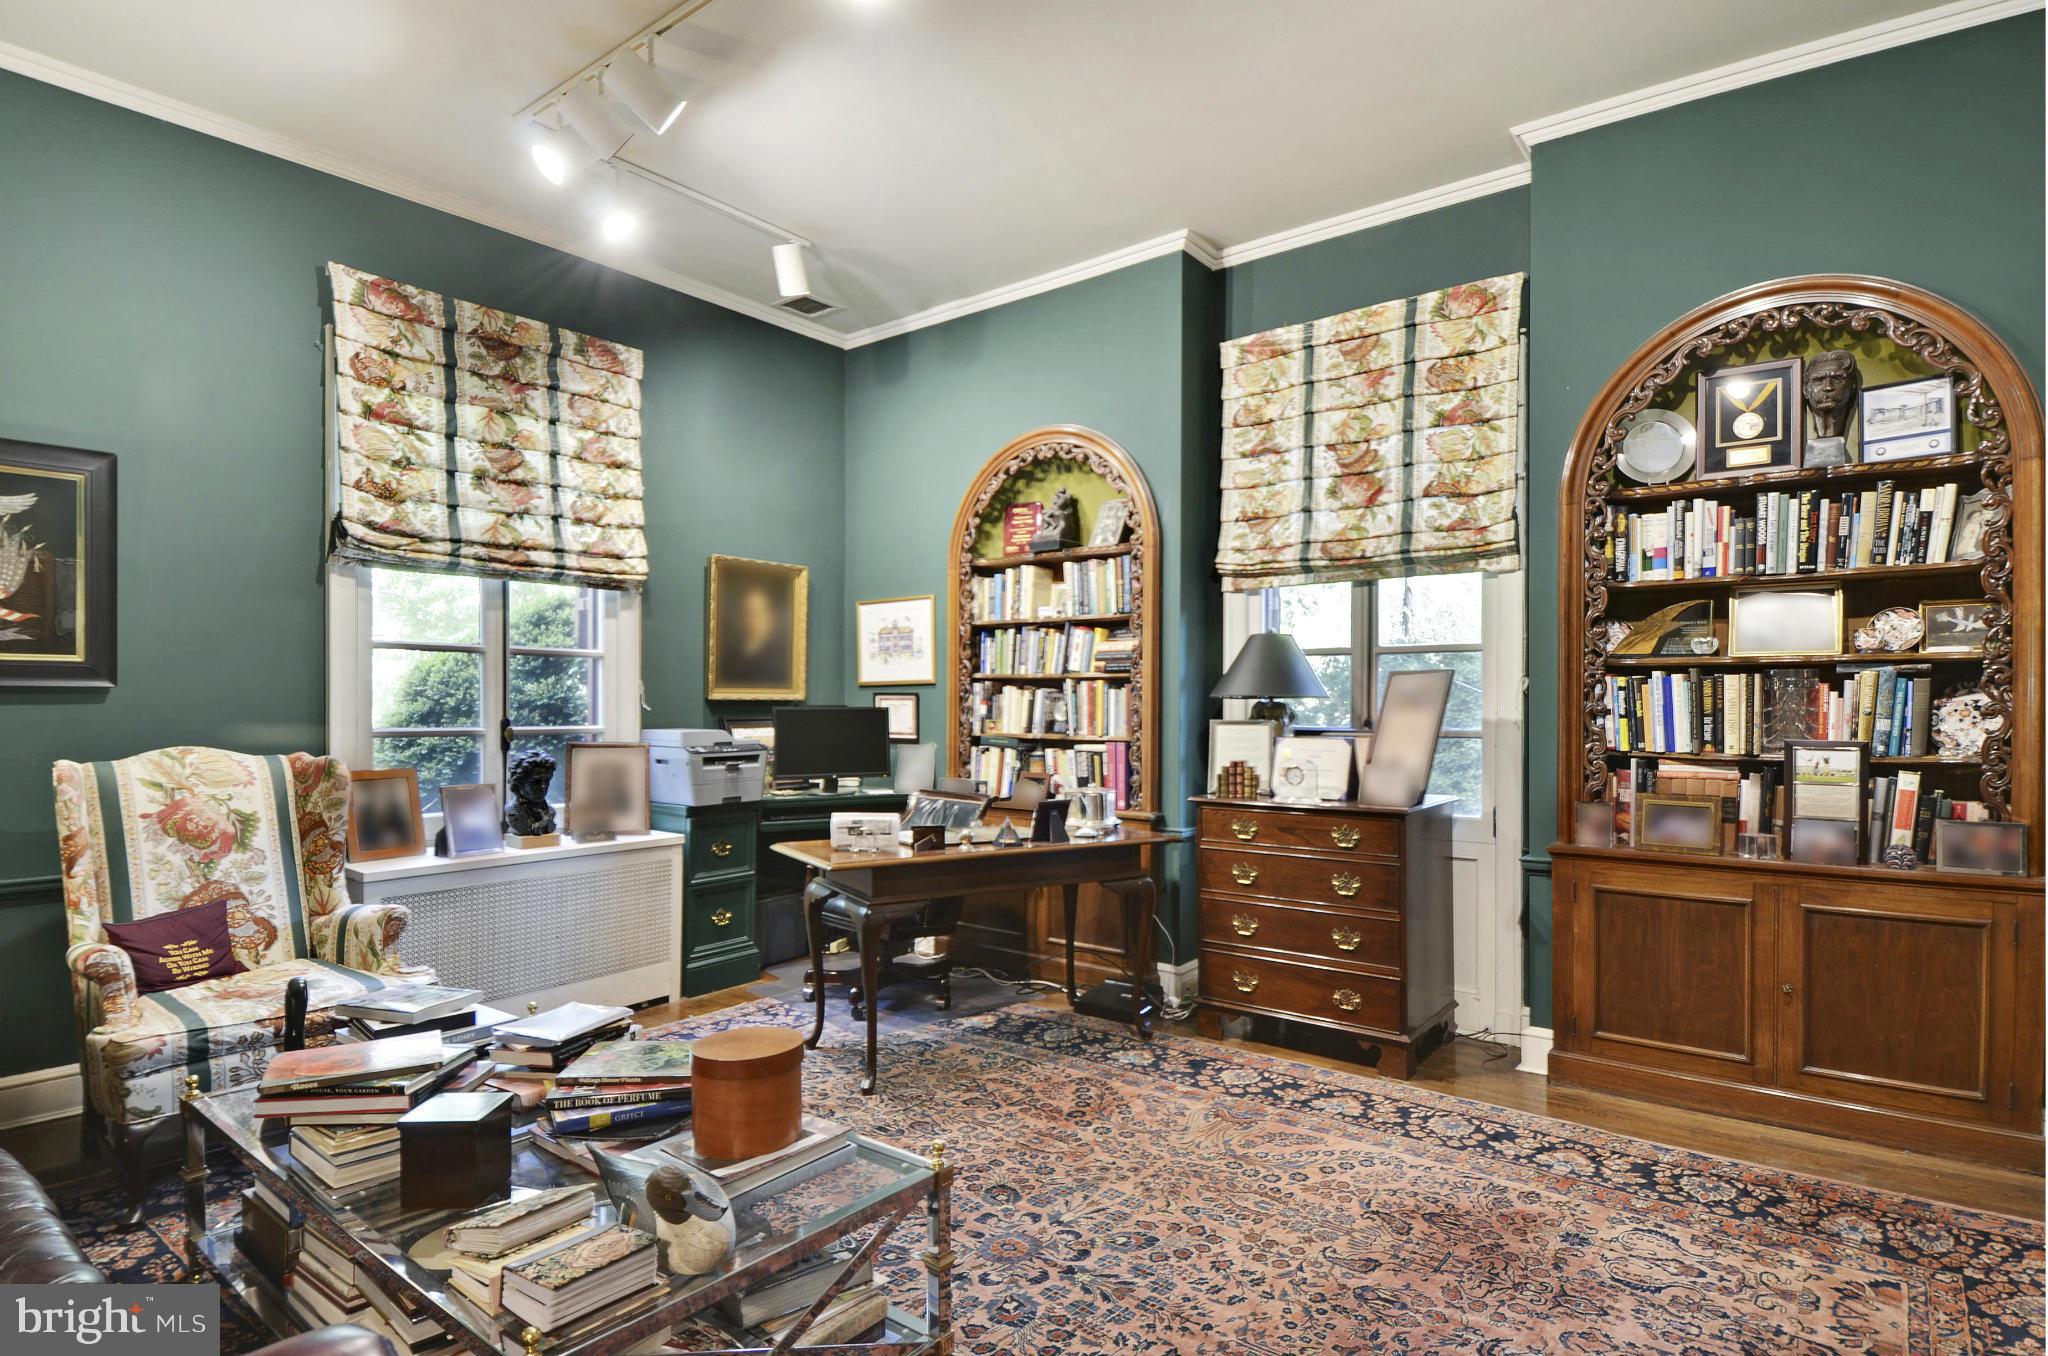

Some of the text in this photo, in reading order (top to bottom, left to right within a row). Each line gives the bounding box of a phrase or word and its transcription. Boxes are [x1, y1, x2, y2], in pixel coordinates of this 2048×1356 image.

[1876, 484, 1892, 534] SANDRA BROWN
[1757, 495, 1768, 545] STUART WOODS
[291, 1082, 318, 1091] Roses
[553, 1092, 662, 1110] THE BOOK OF PERFUME
[614, 1111, 645, 1122] GREECE
